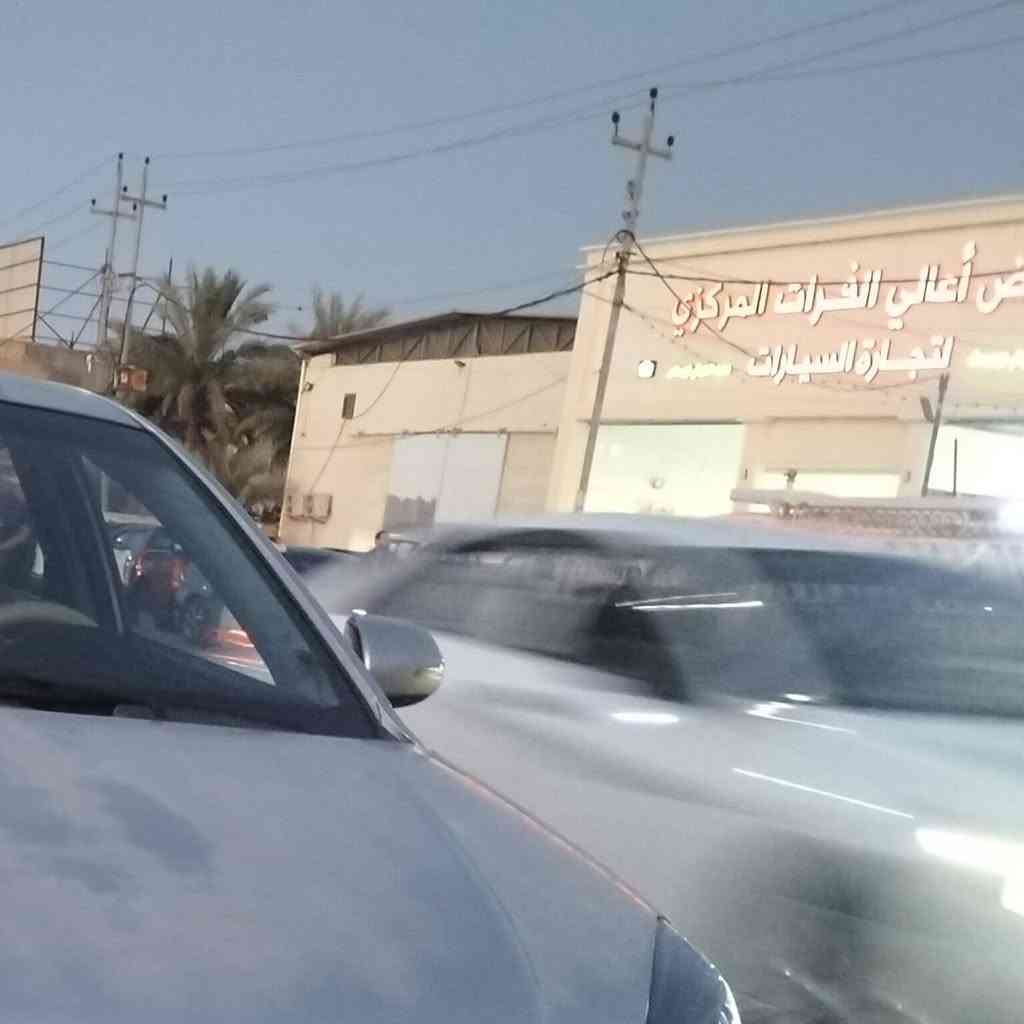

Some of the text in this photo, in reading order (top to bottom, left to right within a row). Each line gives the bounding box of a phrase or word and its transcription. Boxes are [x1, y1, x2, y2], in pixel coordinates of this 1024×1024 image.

[671, 280, 772, 337] المركزي
[773, 260, 885, 327] الفرات
[885, 240, 977, 331] أعالي
[745, 335, 955, 385] لتجارة السيارات
